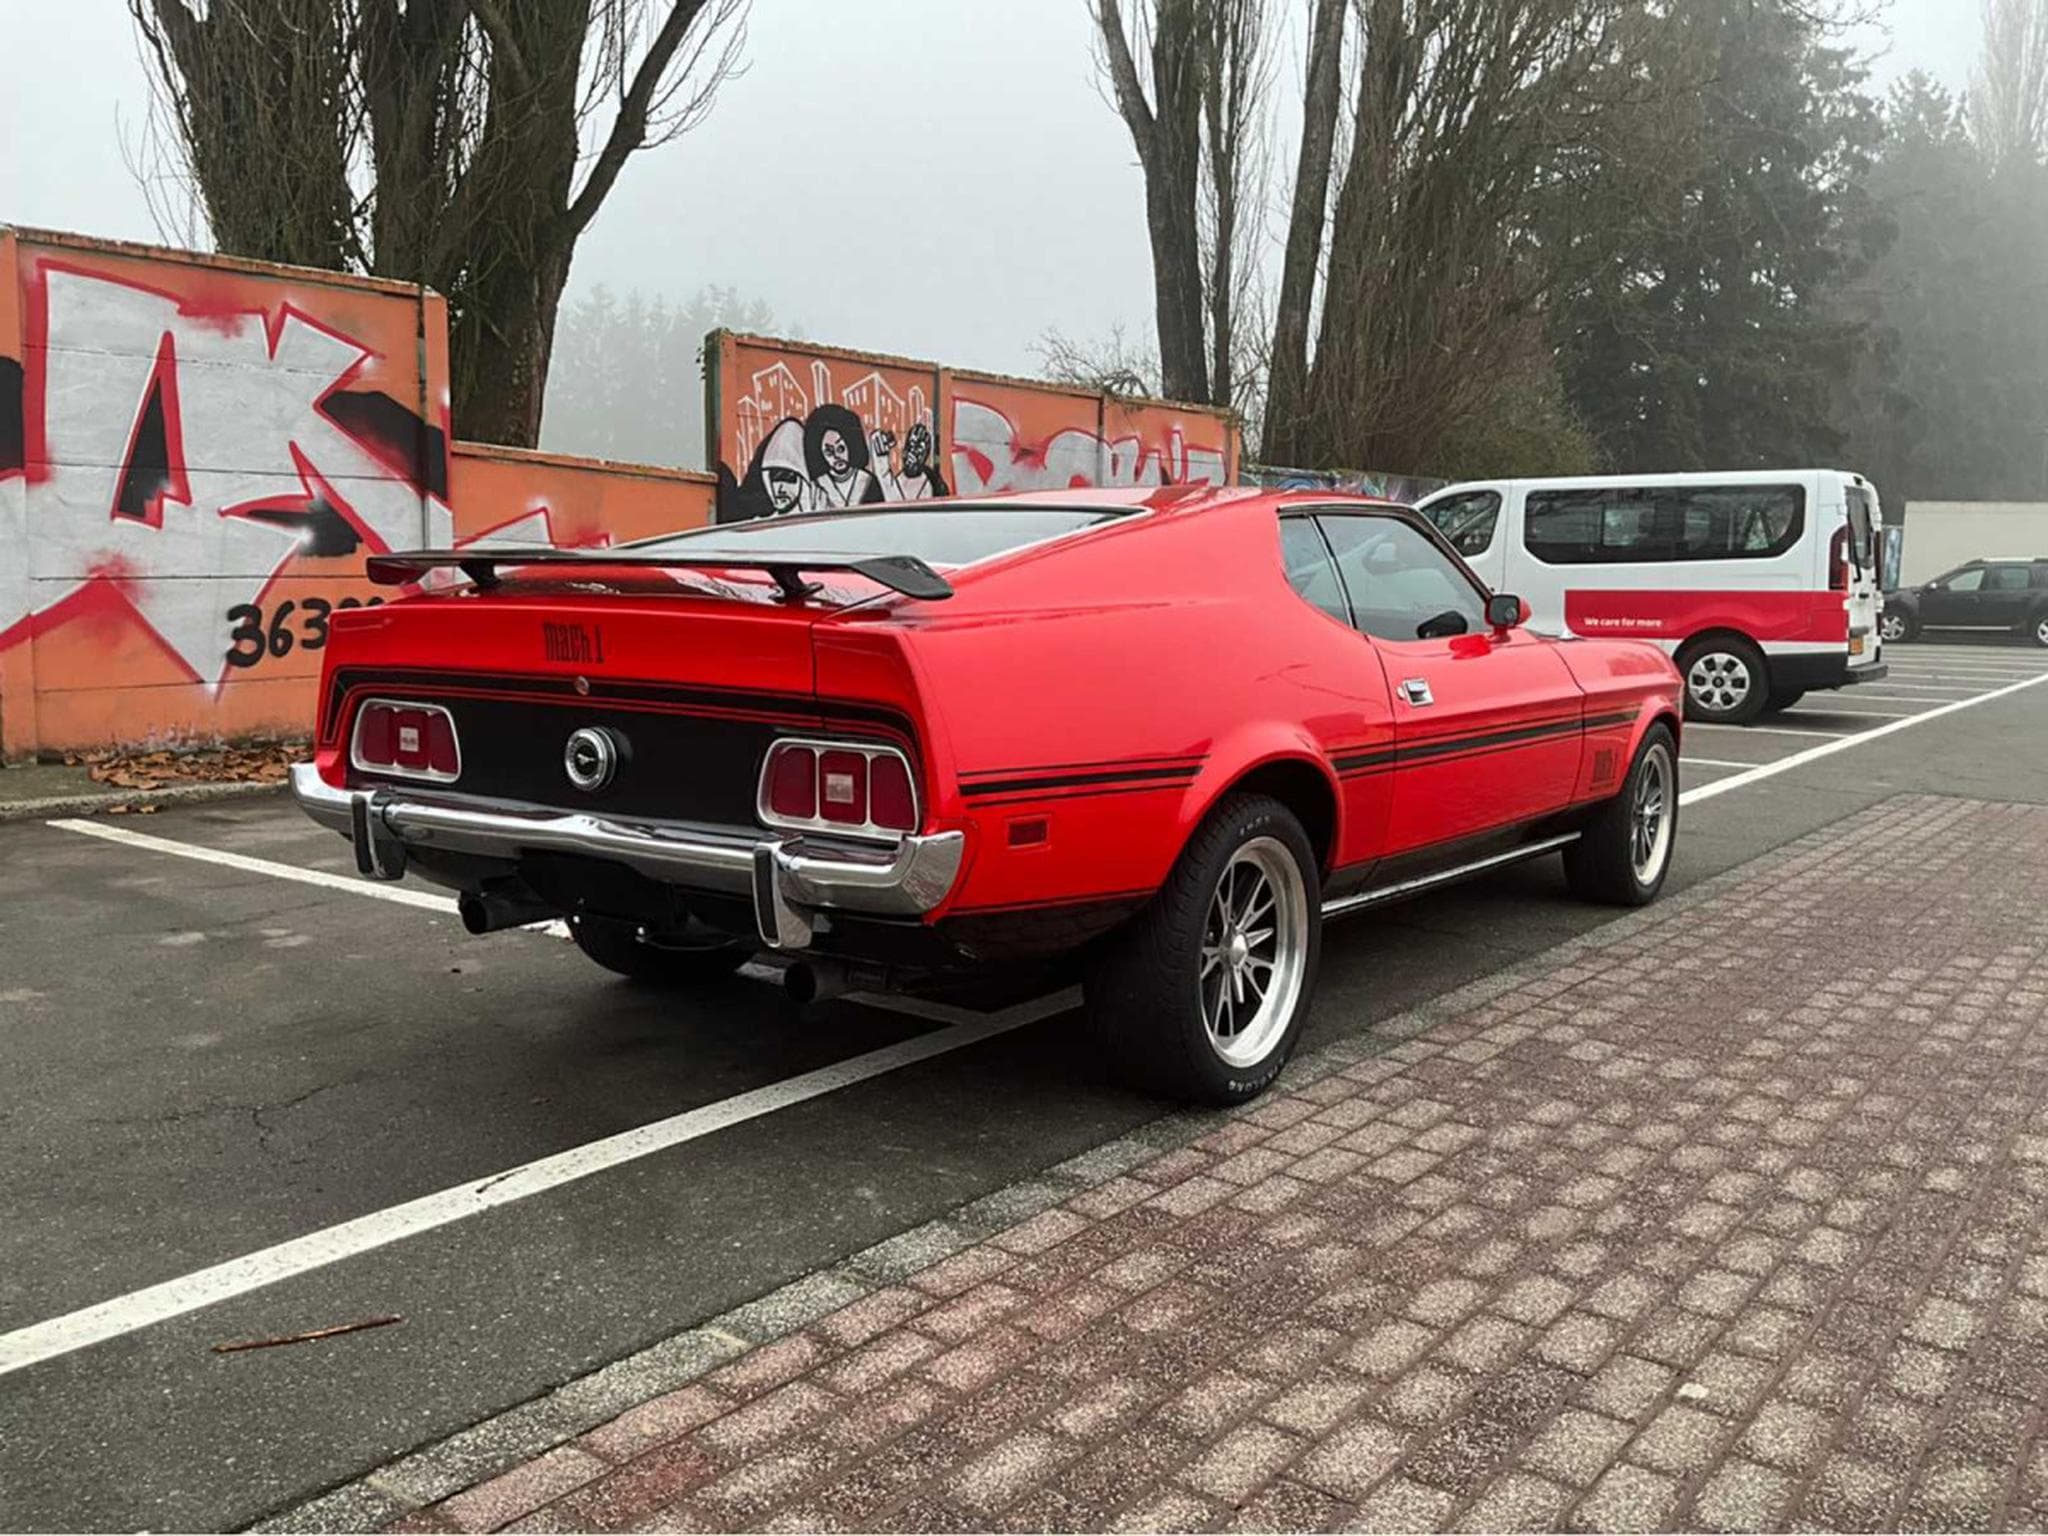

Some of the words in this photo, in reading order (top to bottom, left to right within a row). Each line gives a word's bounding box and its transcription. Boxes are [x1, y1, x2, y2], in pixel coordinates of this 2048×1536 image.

[226, 597, 385, 667] 363
[1583, 617, 1599, 627] We
[1600, 618, 1620, 627] care
[1621, 617, 1636, 627] for
[1637, 618, 1662, 628] more
